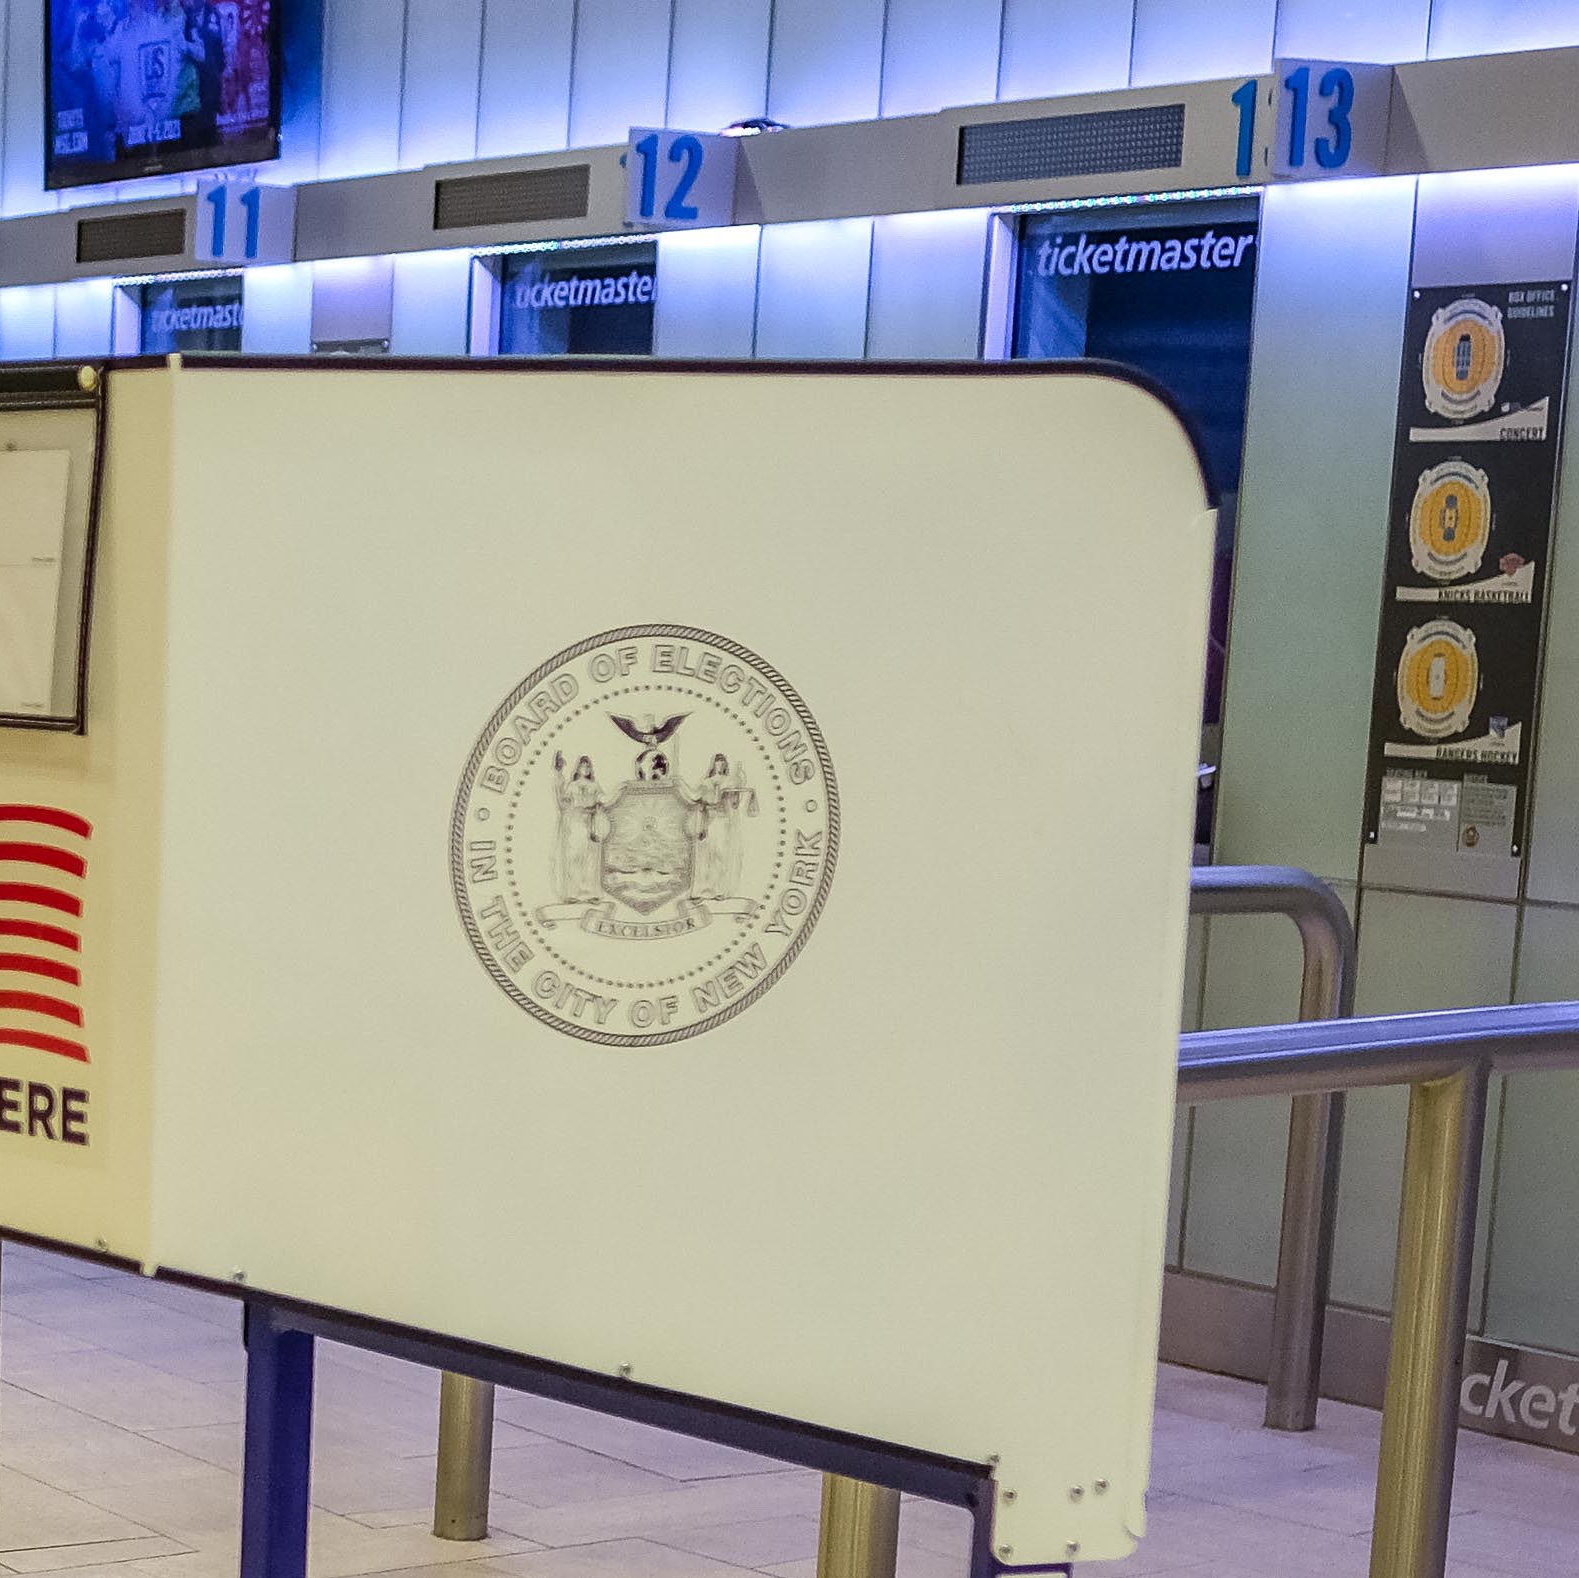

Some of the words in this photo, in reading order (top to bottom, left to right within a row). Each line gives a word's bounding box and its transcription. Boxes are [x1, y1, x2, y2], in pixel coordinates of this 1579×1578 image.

[1231, 79, 1273, 177] 1
[1284, 67, 1355, 169] 13
[636, 133, 703, 219] 12
[207, 185, 261, 259] 11
[1037, 230, 1256, 277] ticketmaster
[480, 673, 581, 796] BOARD
[590, 645, 640, 683] OF
[651, 643, 816, 786] ELECTIONS
[470, 839, 500, 885] IN
[765, 827, 824, 939] YORK
[479, 895, 535, 973] THE
[596, 917, 697, 938] EXCELSIOR
[531, 970, 619, 1026] CITY
[630, 996, 681, 1028] OF
[691, 942, 769, 1015] NEW
[1459, 1357, 1579, 1437] cket
